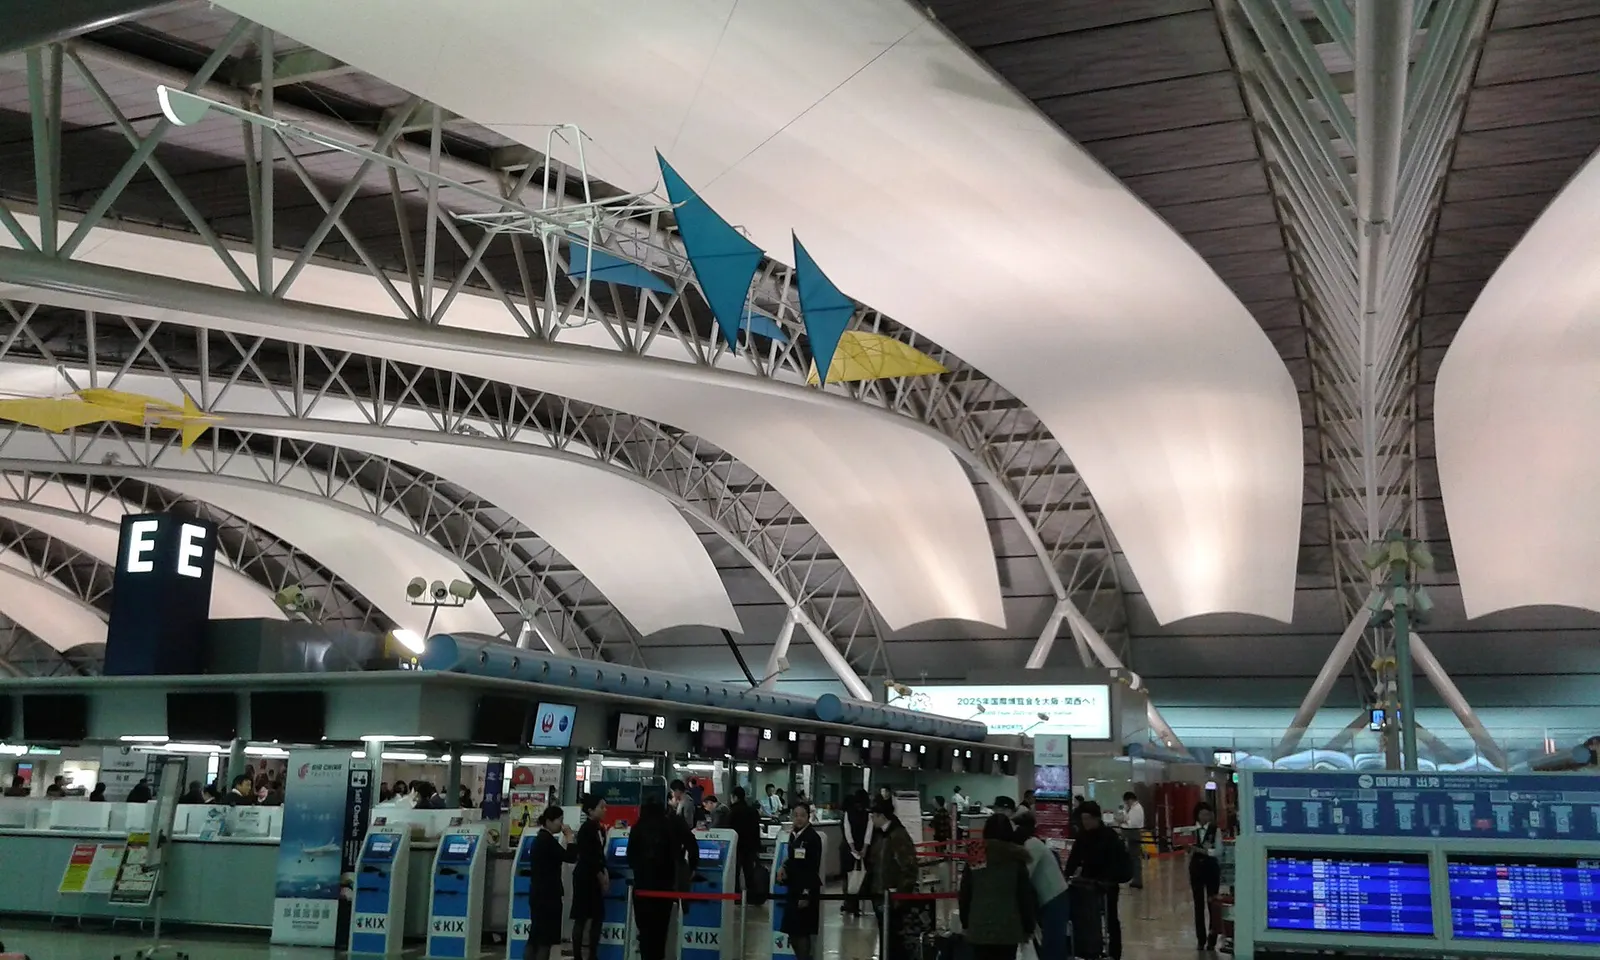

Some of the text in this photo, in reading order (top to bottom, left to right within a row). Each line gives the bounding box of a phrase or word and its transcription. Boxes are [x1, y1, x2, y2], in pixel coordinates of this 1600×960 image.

[127, 520, 158, 573] E
[177, 523, 206, 578] E
[365, 917, 385, 929] KIX
[443, 920, 464, 933] KIX
[695, 932, 718, 944] KIX
